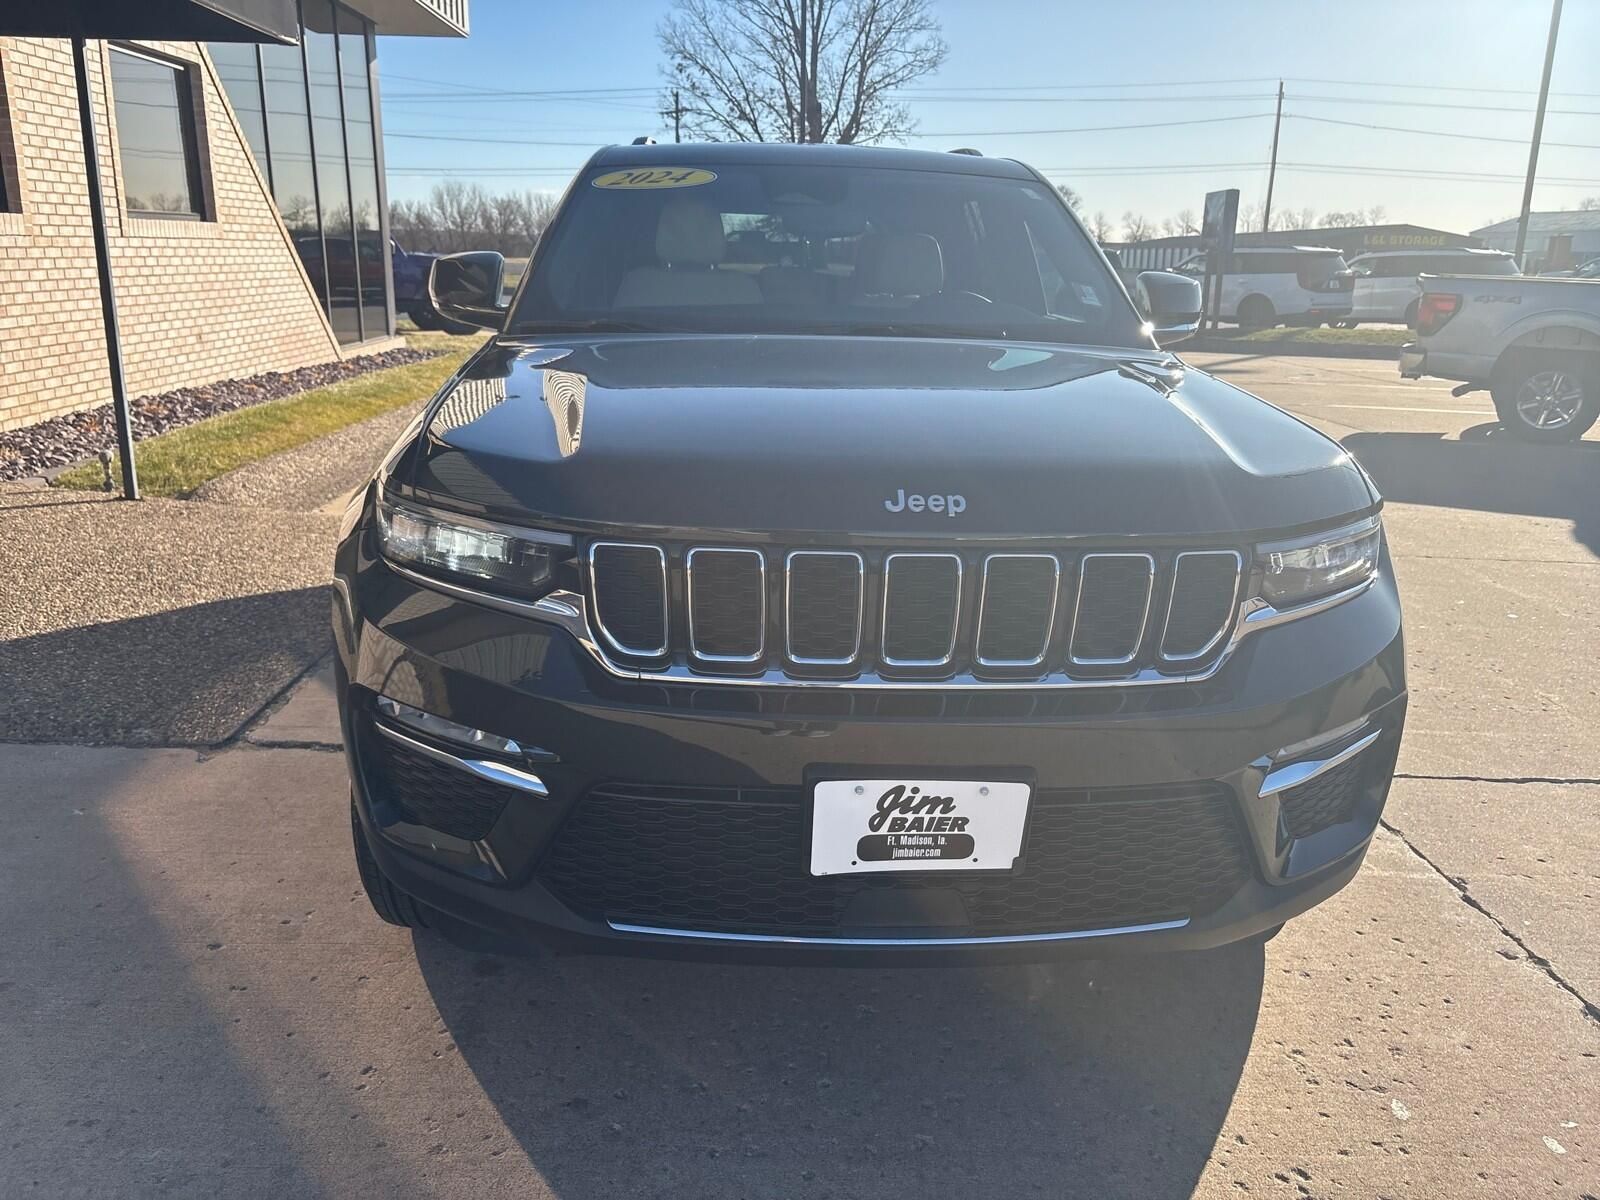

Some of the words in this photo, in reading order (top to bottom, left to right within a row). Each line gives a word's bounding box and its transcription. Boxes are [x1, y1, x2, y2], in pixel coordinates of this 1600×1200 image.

[606, 171, 697, 186] 2024
[1390, 234, 1446, 246] STORAGE
[884, 488, 967, 517] Jeep
[868, 784, 957, 833] Jim
[886, 816, 970, 833] BAIER
[887, 835, 897, 846] Ft.
[899, 835, 935, 847] Madison,
[892, 847, 942, 860] jimbaier.com
